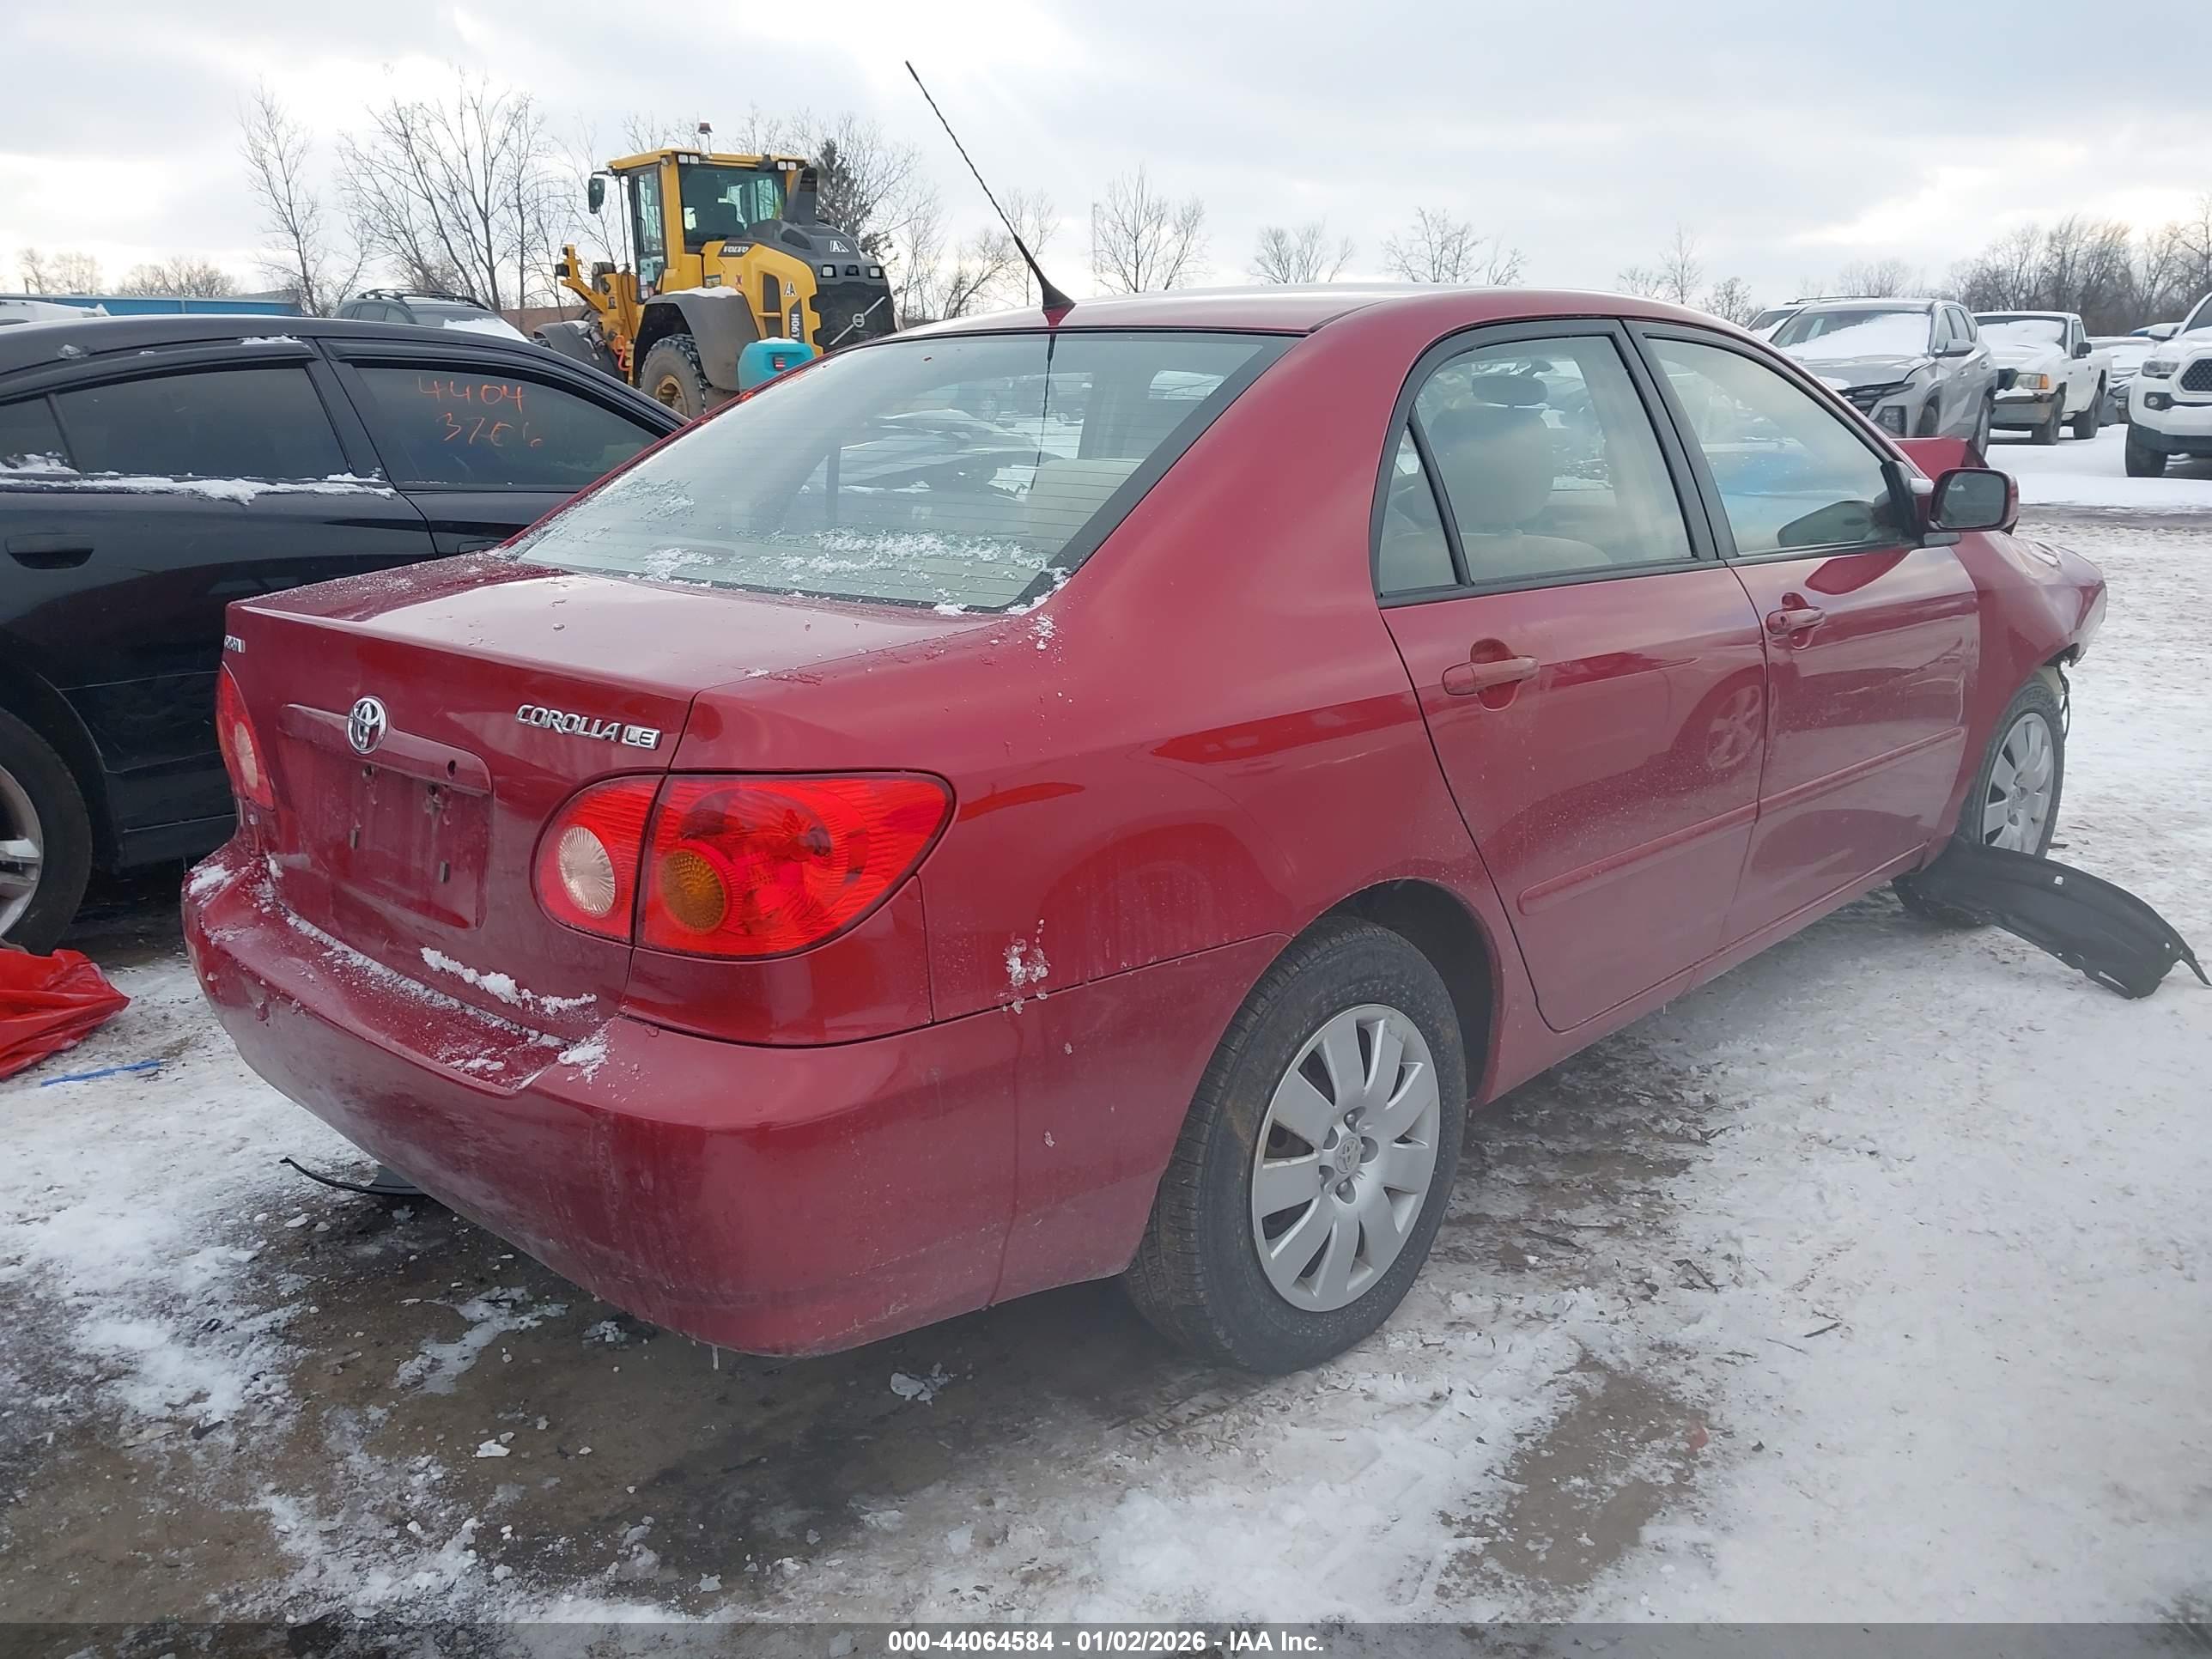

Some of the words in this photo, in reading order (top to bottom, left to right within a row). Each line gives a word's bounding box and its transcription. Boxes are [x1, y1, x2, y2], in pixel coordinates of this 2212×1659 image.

[790, 313, 800, 338] L90H
[418, 377, 528, 415] 4404
[515, 703, 622, 743] COROLLA
[623, 725, 660, 749] LE
